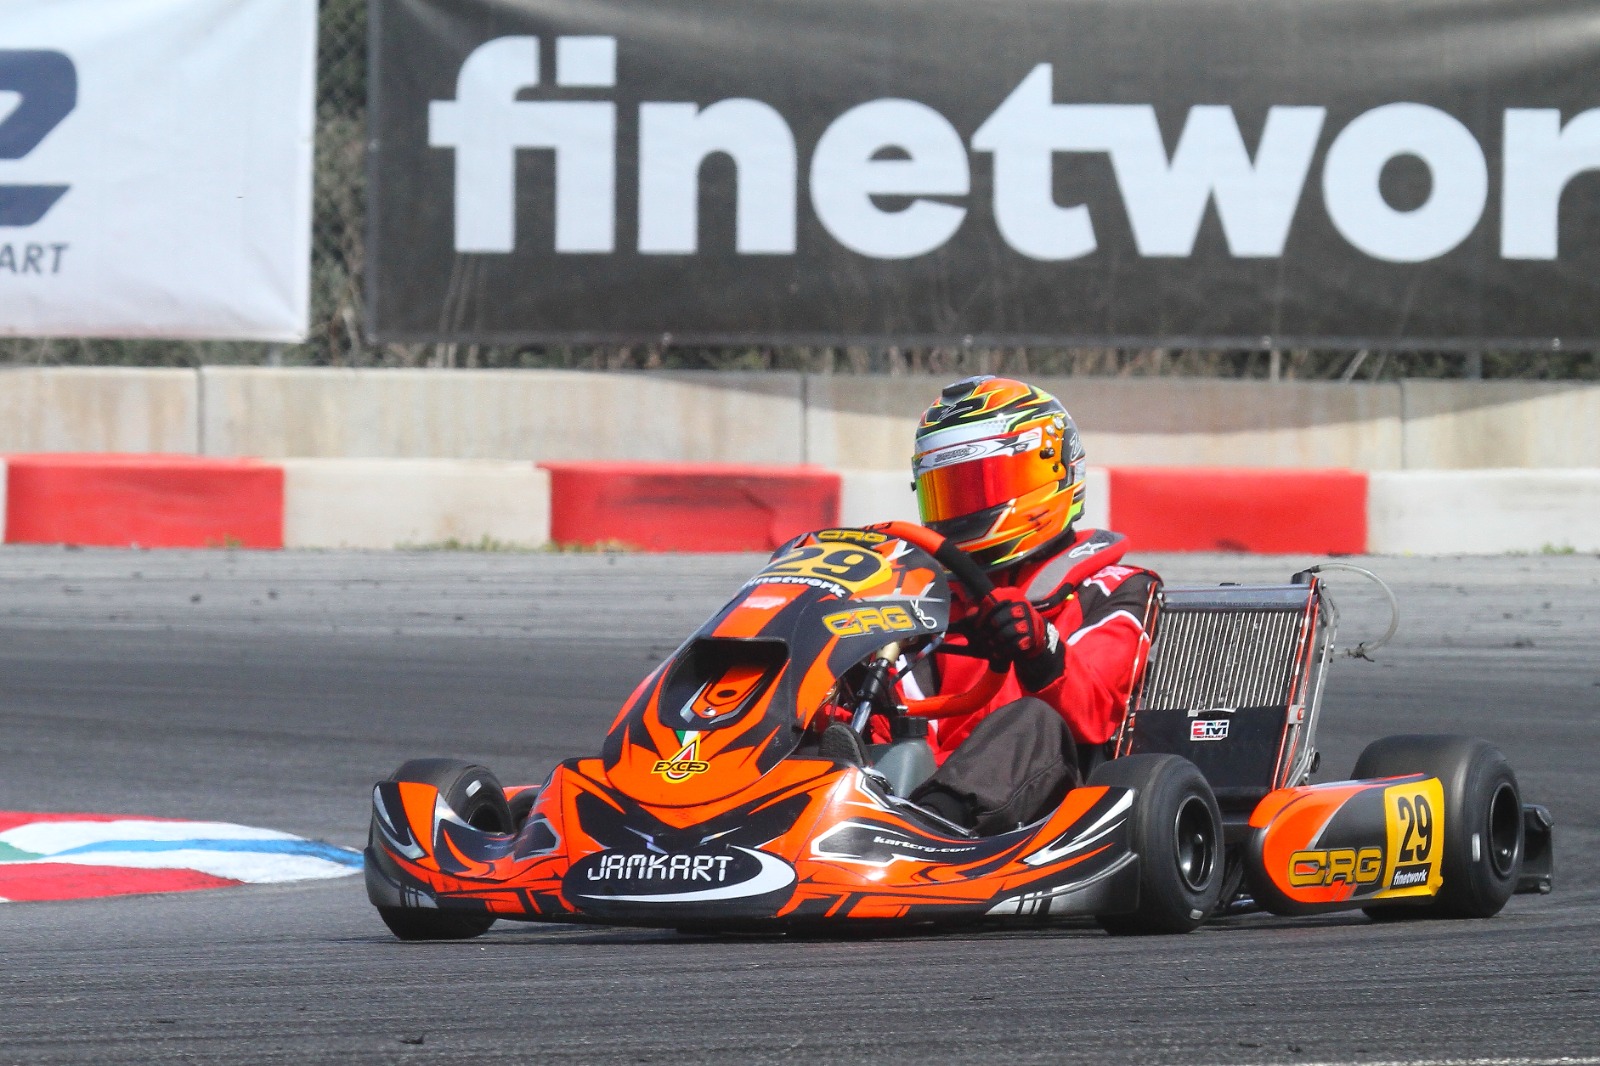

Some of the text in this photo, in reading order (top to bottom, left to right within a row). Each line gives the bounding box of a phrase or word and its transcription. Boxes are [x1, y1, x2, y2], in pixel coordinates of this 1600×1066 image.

[818, 530, 887, 542] CRG
[761, 547, 882, 582] 29
[823, 606, 914, 637] CRG
[1397, 794, 1433, 863] 29
[587, 855, 734, 881] JAMKART
[1289, 847, 1384, 887] CRG
[1393, 868, 1428, 886] finetwork
